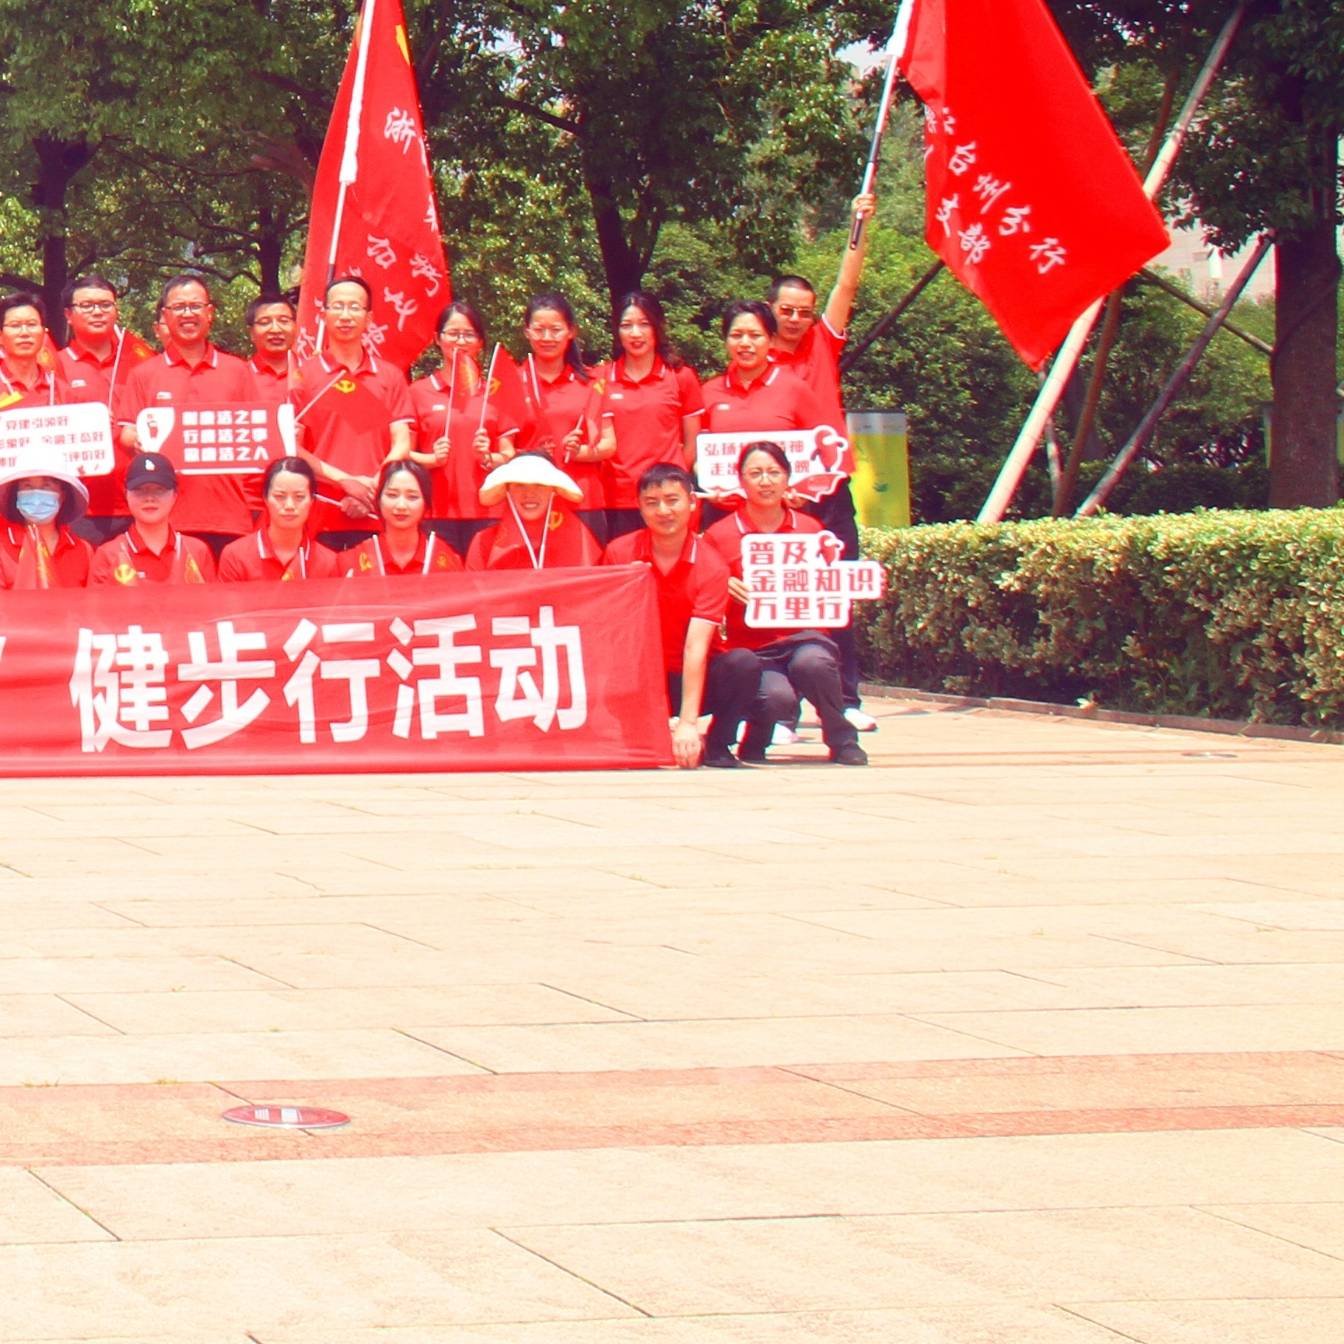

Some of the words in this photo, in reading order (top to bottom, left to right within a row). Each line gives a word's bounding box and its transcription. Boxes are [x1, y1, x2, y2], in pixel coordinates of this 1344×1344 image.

[748, 540, 809, 566] 普及
[750, 567, 874, 593] 金融知识
[751, 596, 844, 621] 万里行
[69, 606, 587, 754] 健步行活动
